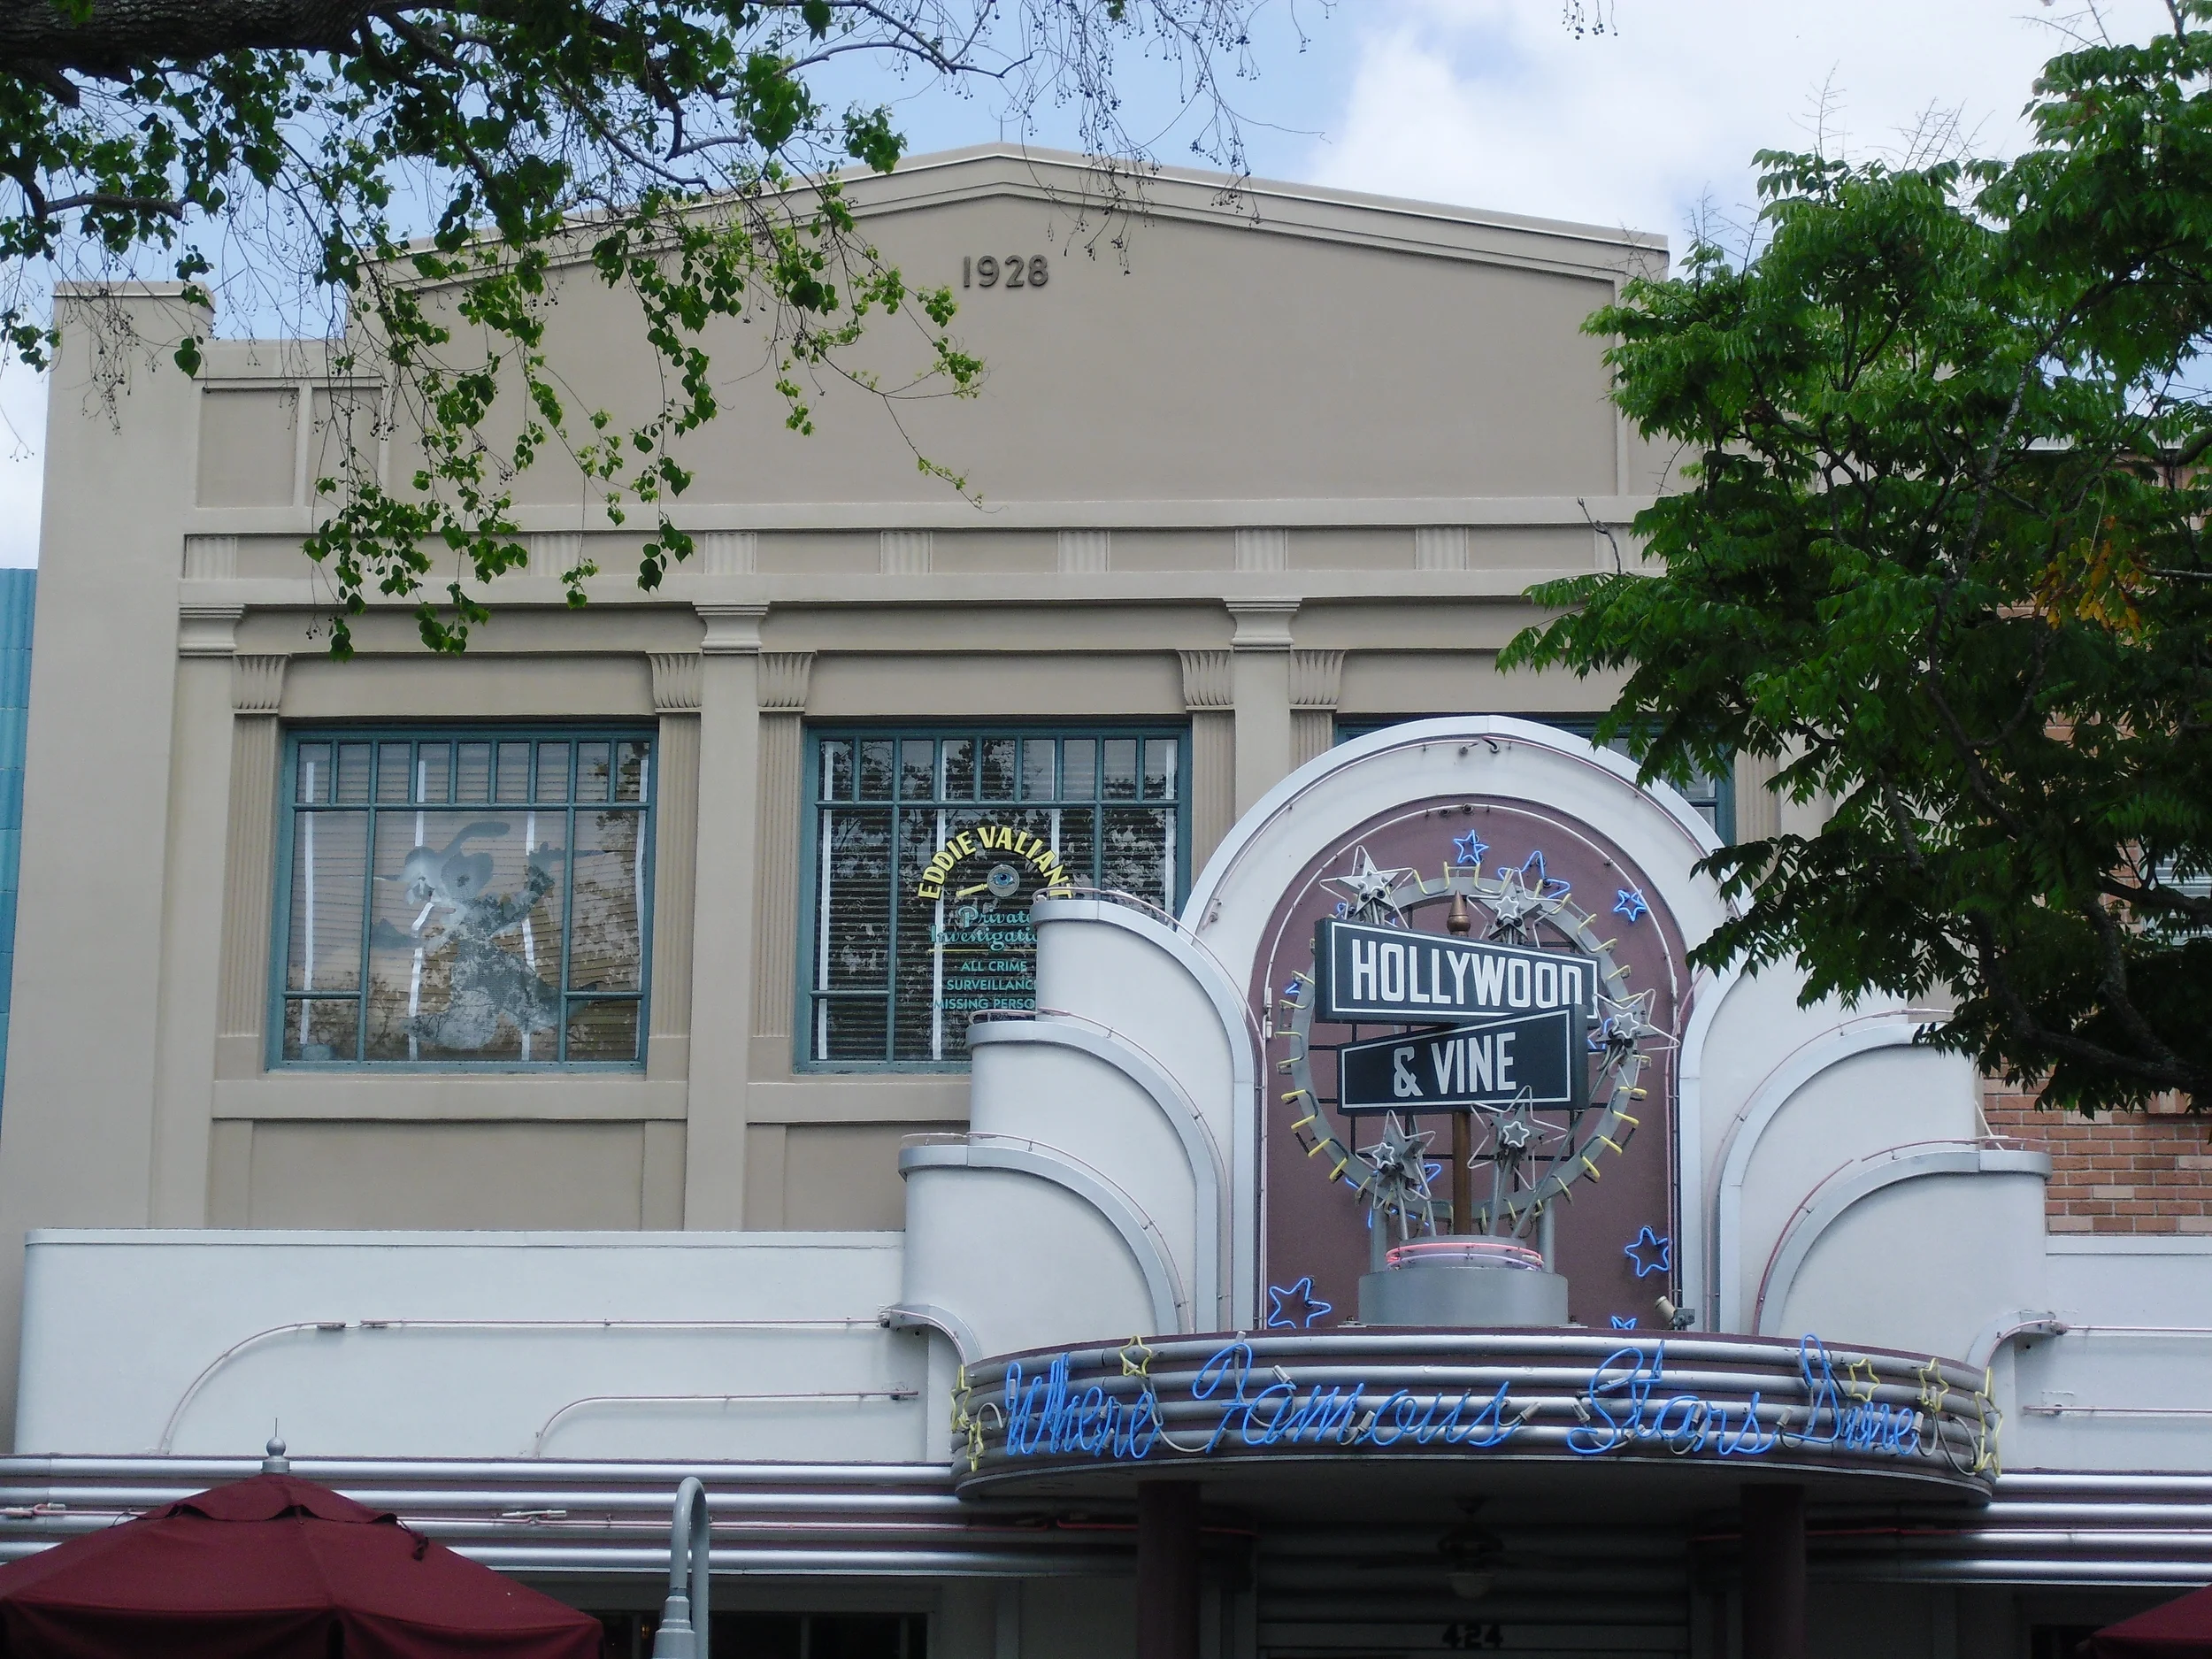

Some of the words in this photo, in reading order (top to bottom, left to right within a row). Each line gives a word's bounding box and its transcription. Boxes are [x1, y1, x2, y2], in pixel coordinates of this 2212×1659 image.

[963, 254, 1048, 288] 1928
[918, 830, 977, 900] EDDIE
[977, 826, 1072, 899] VALIANT
[960, 961, 985, 972] ALL
[988, 961, 1027, 972] CRIME
[1351, 939, 1583, 1009] HOLLYWOOD
[947, 979, 1036, 991] SURVEILLANC
[933, 998, 989, 1010] MISSING
[1393, 1047, 1424, 1097] &
[1432, 1032, 1517, 1094] VINE
[1004, 1351, 1163, 1460] Where
[1192, 1342, 1524, 1455] Famous
[1567, 1340, 1778, 1455] Stars
[1441, 1623, 1504, 1648] 424
